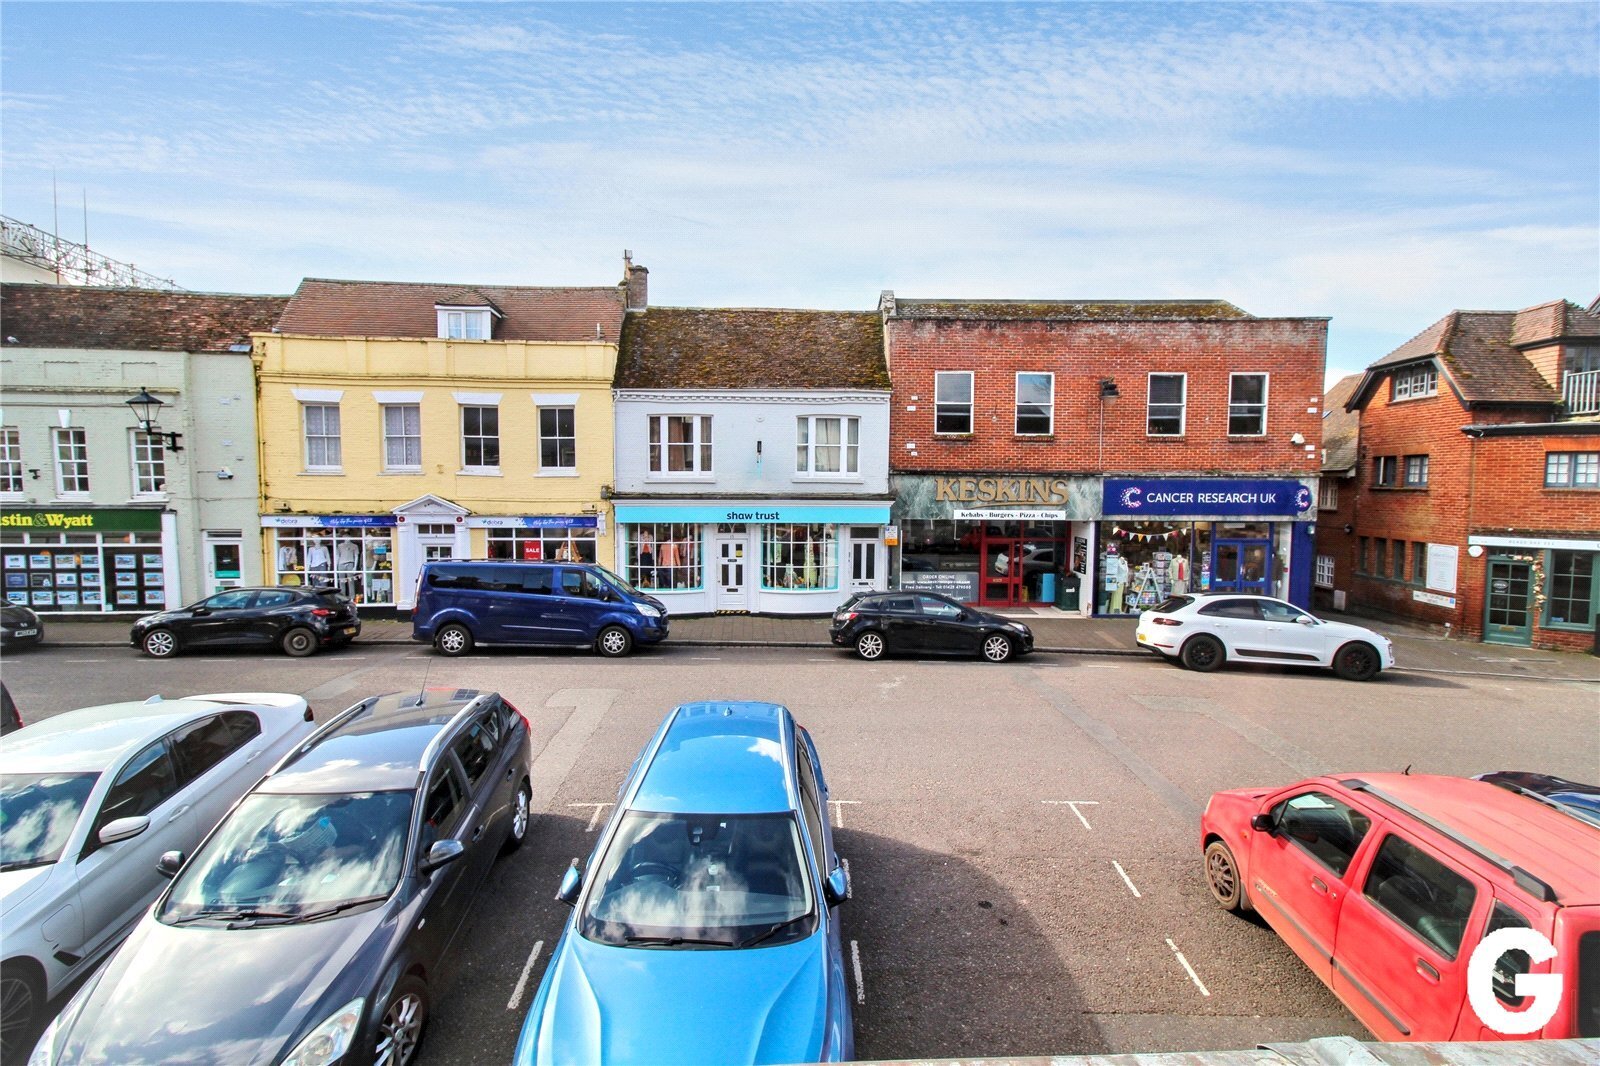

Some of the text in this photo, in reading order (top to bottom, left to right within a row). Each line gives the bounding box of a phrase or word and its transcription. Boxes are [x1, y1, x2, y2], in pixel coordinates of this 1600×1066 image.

[935, 477, 1069, 506] KESKINS
[1146, 492, 1276, 503] CANCER RESEARCH UK
[726, 511, 780, 520] shaw trust
